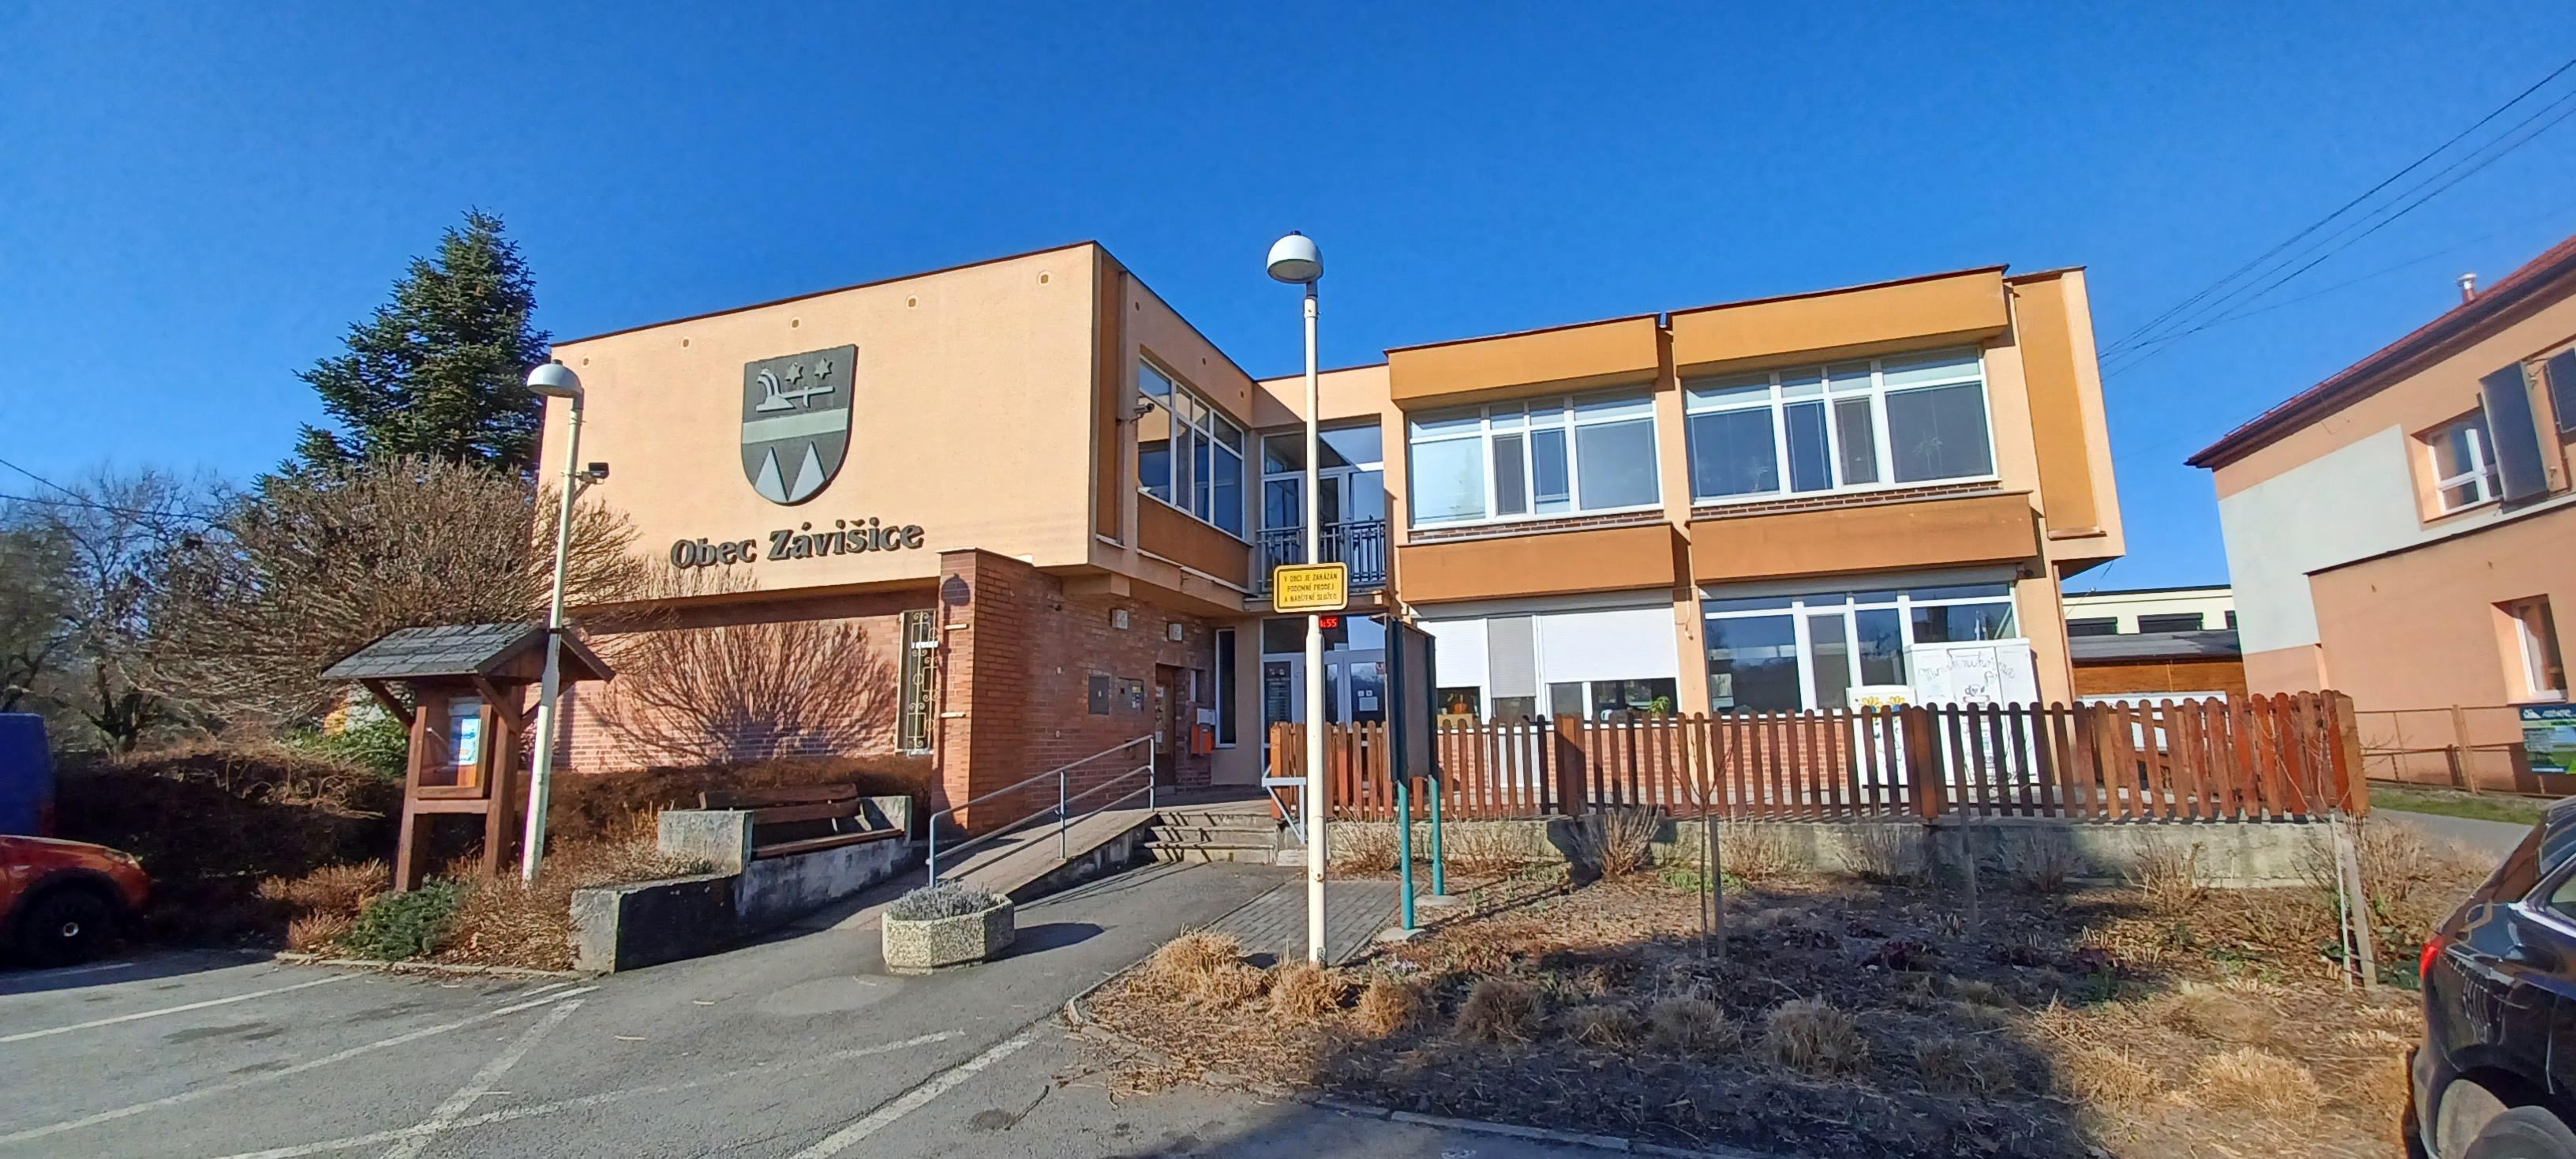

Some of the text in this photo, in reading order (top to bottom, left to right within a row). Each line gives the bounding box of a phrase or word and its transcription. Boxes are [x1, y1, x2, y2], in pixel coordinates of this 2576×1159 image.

[670, 516, 925, 569] Obec Závišice
[1290, 574, 1302, 583] OBCI
[1312, 572, 1338, 581] ZAKÁZÁN
